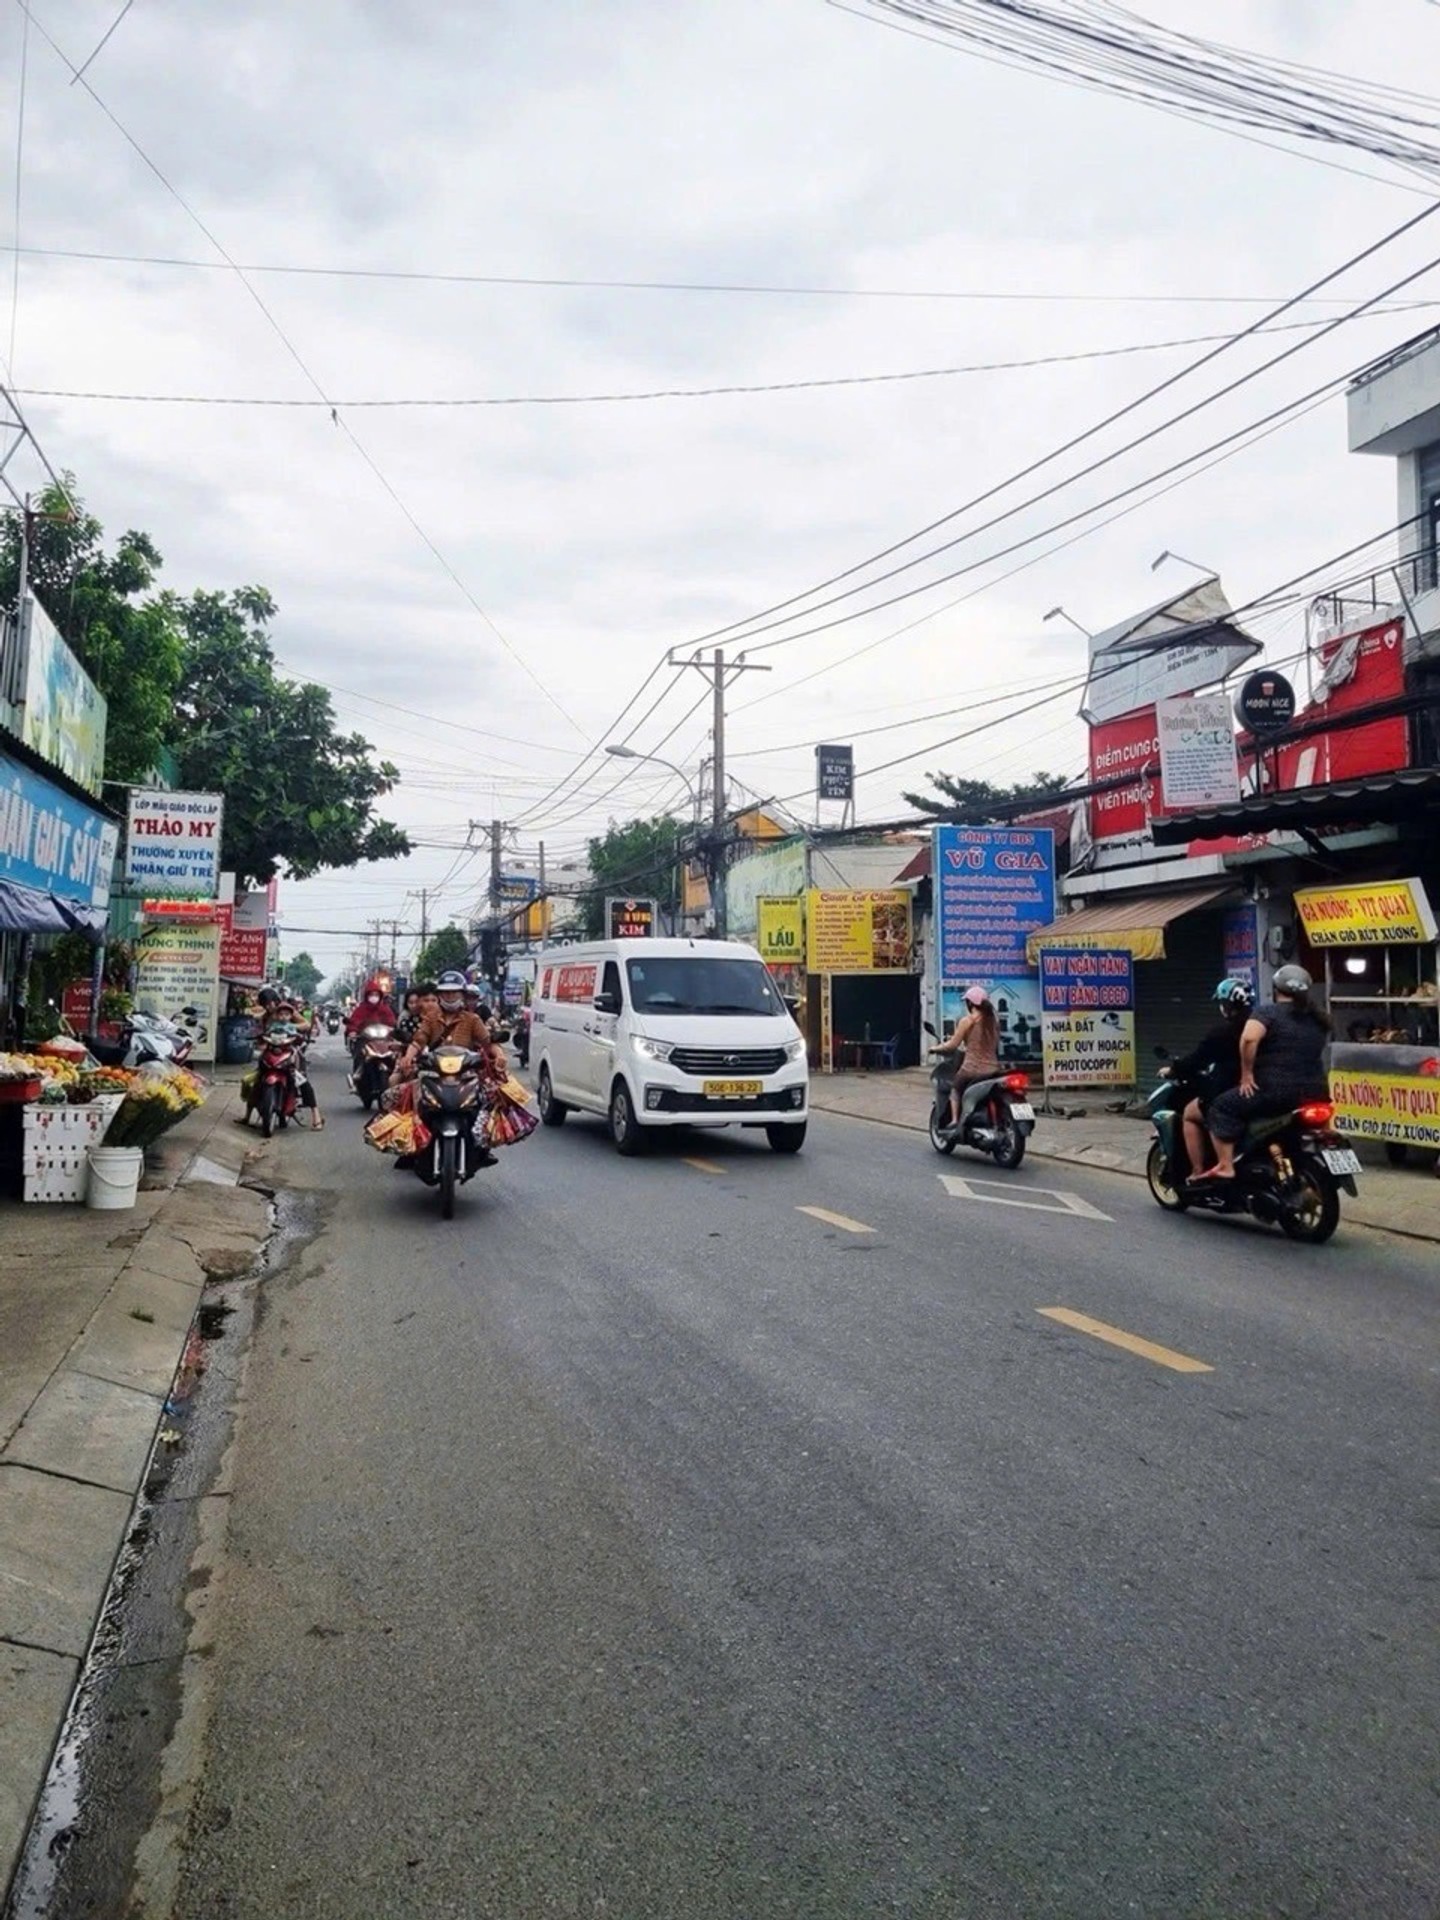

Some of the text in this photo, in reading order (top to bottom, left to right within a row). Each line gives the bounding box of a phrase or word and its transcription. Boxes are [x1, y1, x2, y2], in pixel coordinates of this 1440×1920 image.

[134, 813, 216, 837] THẢO MY
[131, 845, 214, 861] THƯỜNG XUYÊN
[946, 847, 1048, 871] VŨ GIA
[1379, 894, 1411, 920] QUAY
[618, 925, 644, 935] KIM
[1043, 952, 1129, 977] VAY NGÂN HÀNG
[1044, 986, 1068, 1005] VAY
[1051, 1019, 1073, 1032] NHÀ
[1074, 1040, 1094, 1054] QUY
[1098, 1040, 1131, 1053] HOẠCH
[1054, 1059, 1118, 1071] PHOTOCOPPY
[1410, 1090, 1440, 1118] QUAY
